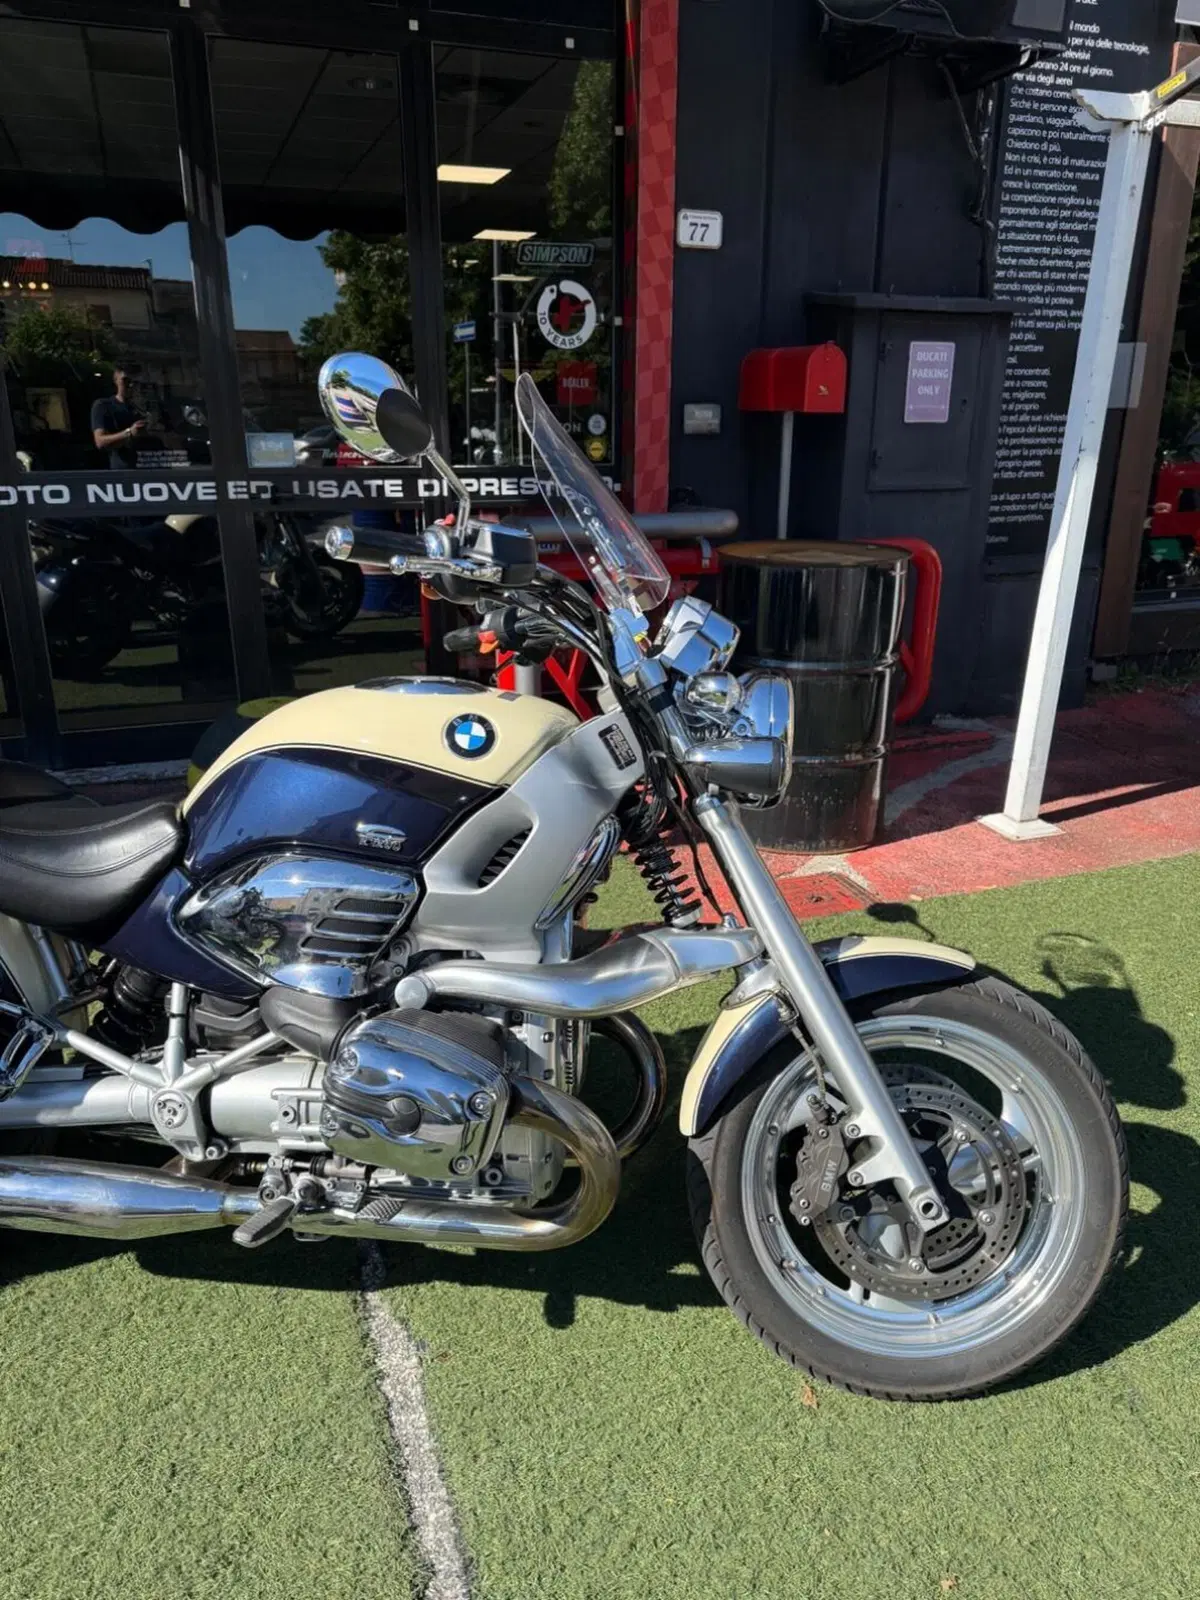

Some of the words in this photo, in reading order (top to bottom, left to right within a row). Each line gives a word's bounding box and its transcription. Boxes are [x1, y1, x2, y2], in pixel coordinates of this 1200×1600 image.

[1074, 22, 1100, 33] mondo
[1071, 36, 1084, 47] per
[1085, 37, 1095, 47] via
[1096, 38, 1113, 50] delle
[1114, 41, 1150, 56] tecnologie,
[1059, 62, 1068, 71] 24
[1070, 64, 1081, 73] ore
[1082, 64, 1089, 74] al
[1090, 66, 1114, 78] giorno.
[1025, 72, 1036, 82] via
[1037, 73, 1054, 86] degli
[1056, 76, 1073, 86] aerei
[1011, 85, 1025, 95] che
[1025, 88, 1052, 97] costano
[1032, 100, 1039, 110] le
[1040, 103, 1068, 114] persone
[1009, 114, 1044, 124] guardano,
[1007, 126, 1041, 137] capiscono
[1048, 130, 1060, 139] poi
[1060, 131, 1106, 143] naturalmente
[1006, 138, 1040, 149] Chiedono
[1041, 141, 1049, 151] di
[1005, 152, 1020, 162] Non
[1021, 154, 1026, 163] è
[1027, 154, 1041, 165] crisi,
[1043, 155, 1047, 164] è
[1049, 156, 1062, 165] crisi
[1062, 156, 1069, 166] di
[1004, 165, 1014, 175] Ed
[1015, 167, 1022, 176] in
[1033, 168, 1061, 178] mercato
[1062, 169, 1074, 179] che
[1075, 171, 1100, 181] matura
[1002, 180, 1024, 189] cresce
[1024, 180, 1031, 189] la
[1001, 192, 1010, 201] La
[1011, 193, 1057, 204] competizione
[1057, 196, 1085, 207] migliora
[1086, 196, 1092, 205] la
[1000, 204, 1040, 215] imponendo
[1041, 208, 1059, 217] sforzi
[1060, 210, 1071, 219] per
[689, 222, 710, 242] 77
[999, 219, 1045, 229] giornalmente
[1045, 220, 1058, 232] agli
[1059, 222, 1088, 231] standard
[998, 231, 1006, 240] La
[1007, 231, 1041, 241] situazione
[1042, 234, 1056, 242] non
[1057, 233, 1062, 242] è
[1062, 234, 1080, 244] dura,
[522, 245, 589, 263] SIMPSON
[1002, 245, 1051, 254] estremamente
[1052, 246, 1063, 256] più
[1018, 257, 1039, 266] molto
[1040, 257, 1074, 269] divertente,
[1007, 269, 1017, 278] chi
[1018, 270, 1042, 279] accetta
[1043, 270, 1049, 279] di
[1050, 271, 1066, 280] stare
[1067, 272, 1078, 280] nel
[1022, 283, 1043, 293] regole
[1044, 284, 1056, 293] più
[1056, 284, 1086, 294] moderne
[1028, 295, 1044, 304] volta
[1051, 297, 1074, 306] poteva
[538, 310, 547, 325] 10
[546, 329, 584, 347] YEARS
[1018, 318, 1035, 328] frutti
[1036, 321, 1055, 329] senza
[1055, 321, 1067, 331] più
[916, 351, 948, 362] DUCATI
[912, 368, 949, 379] PARKING
[918, 384, 941, 396] ONLY
[86, 482, 218, 503] NUOVE
[227, 480, 274, 499] ED
[292, 479, 404, 499] USATE
[418, 478, 448, 497] DI
[459, 477, 622, 507] PRESTIGO.
[821, 1159, 838, 1192] BMW
